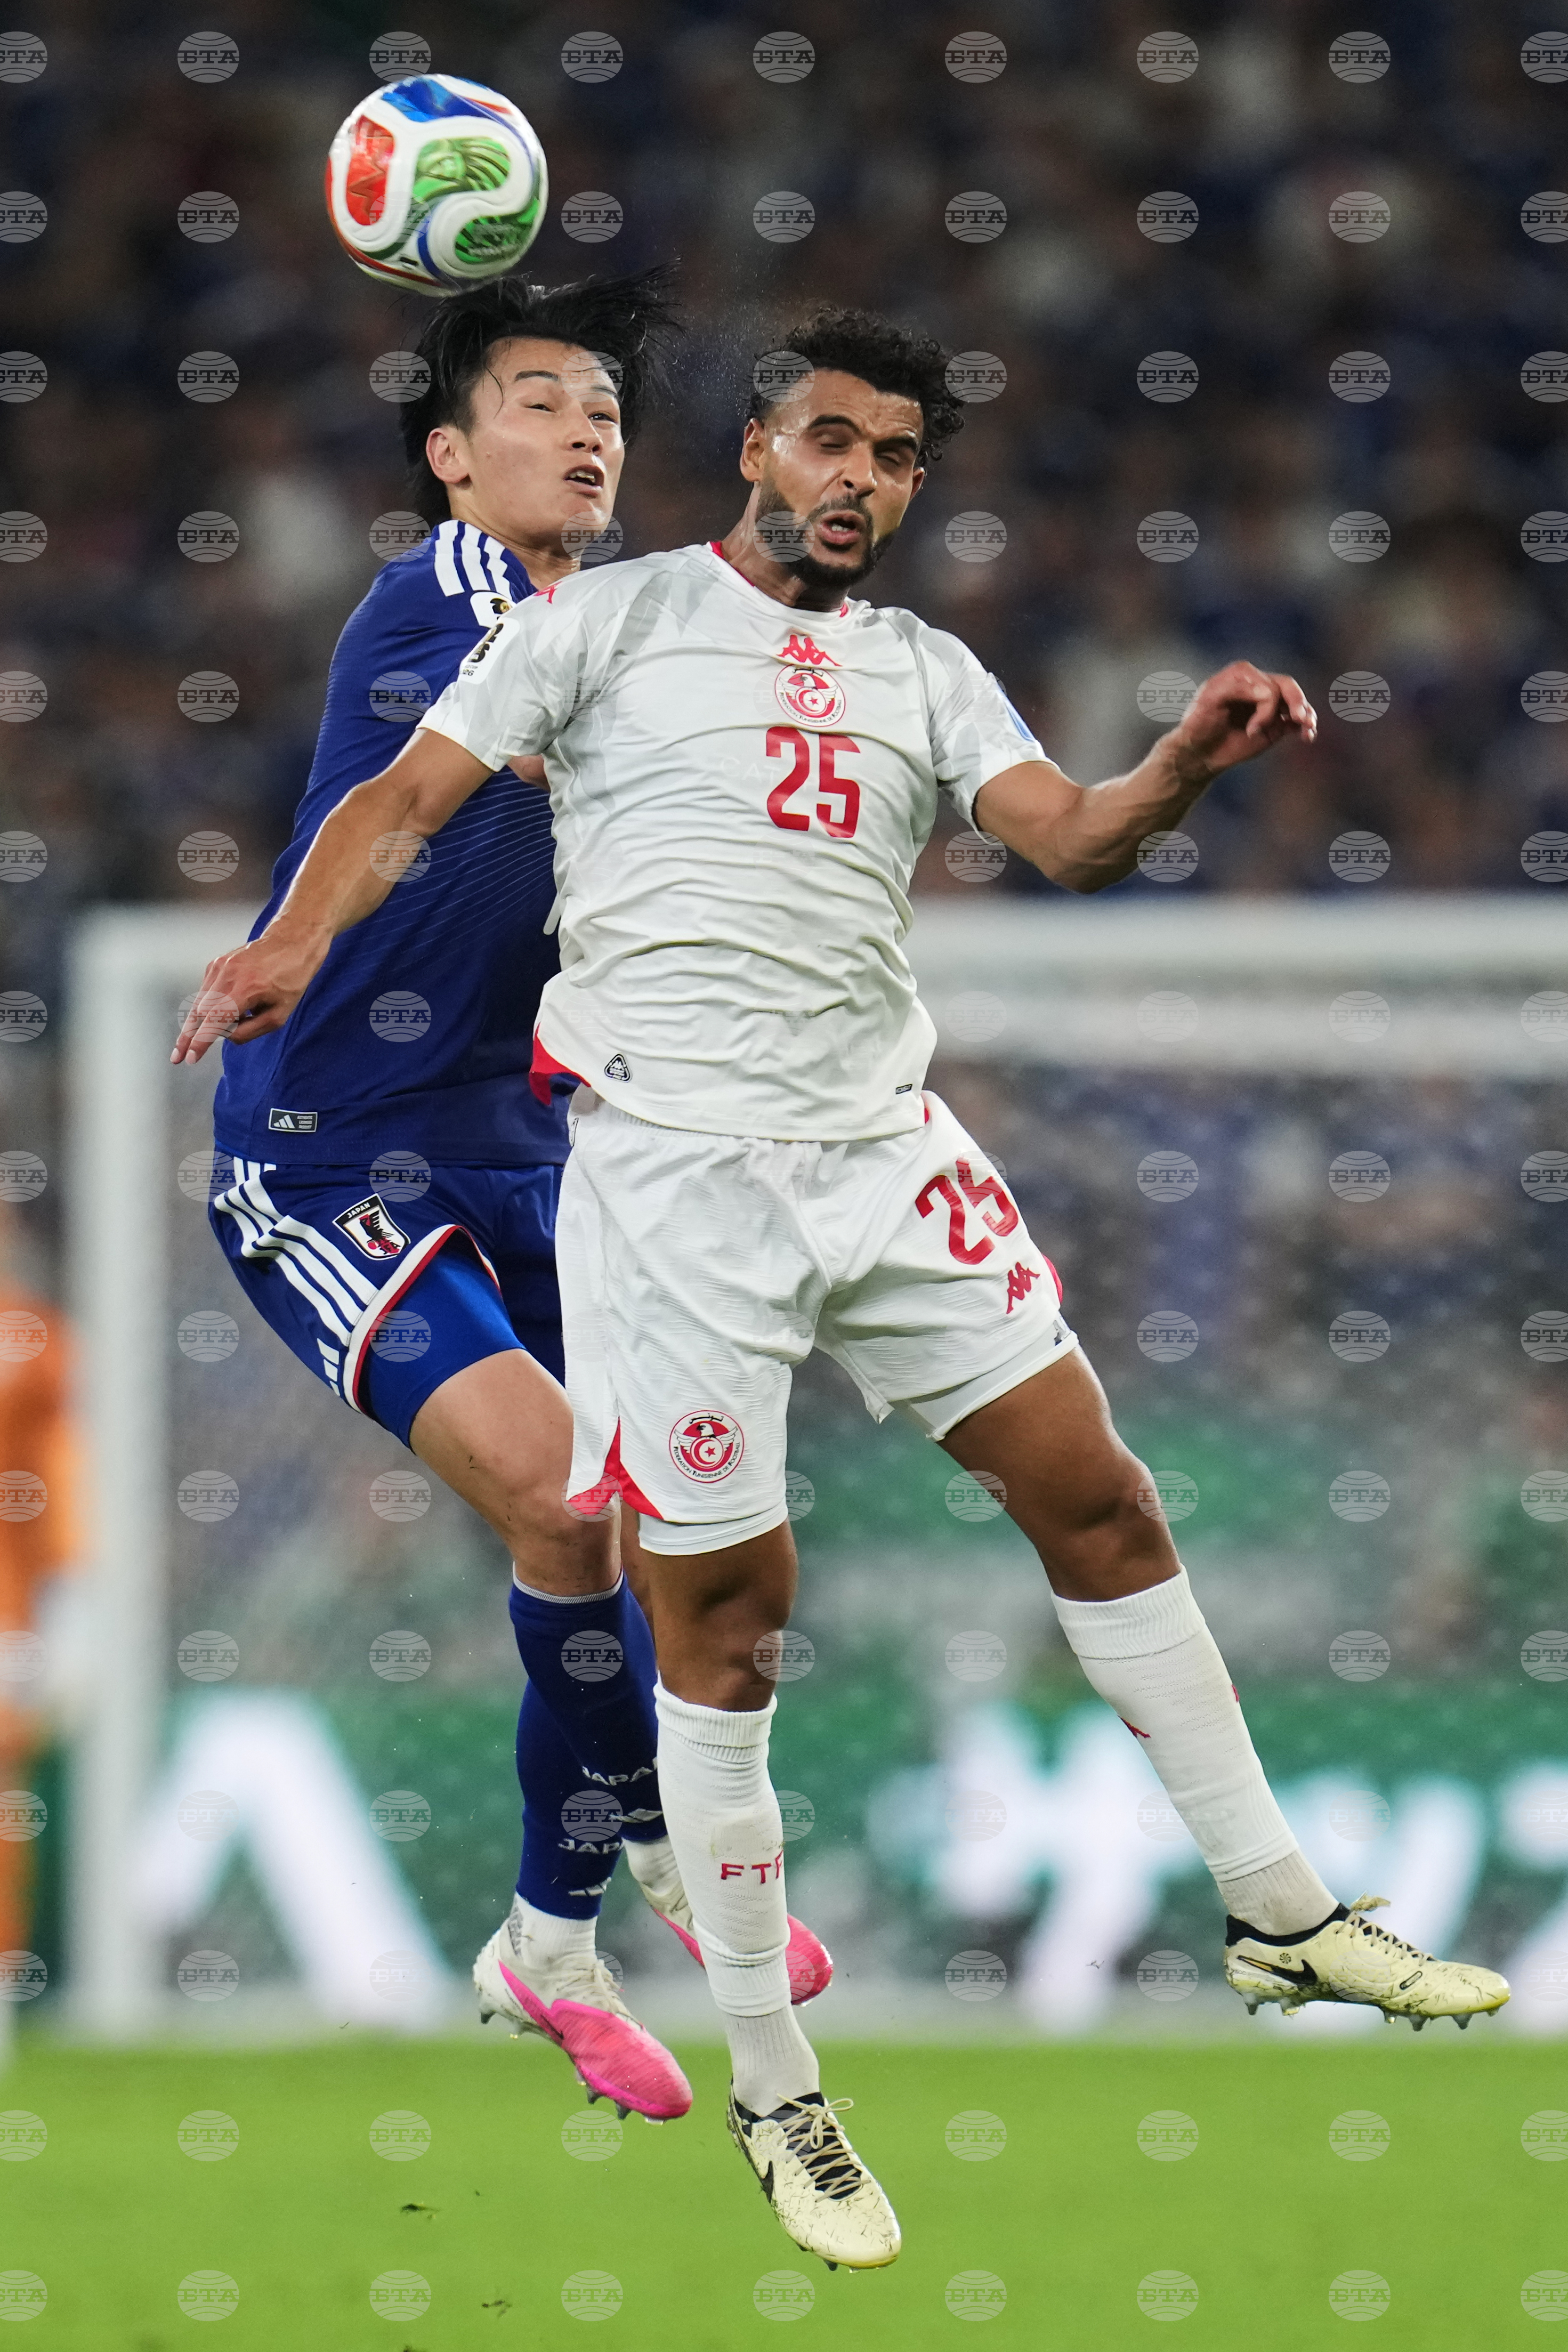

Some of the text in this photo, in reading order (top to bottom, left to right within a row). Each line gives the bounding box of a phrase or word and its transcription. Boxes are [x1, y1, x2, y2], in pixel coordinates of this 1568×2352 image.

[766, 726, 860, 838] 25
[347, 1202, 370, 1219] JAPAN
[915, 1156, 1019, 1265] 25
